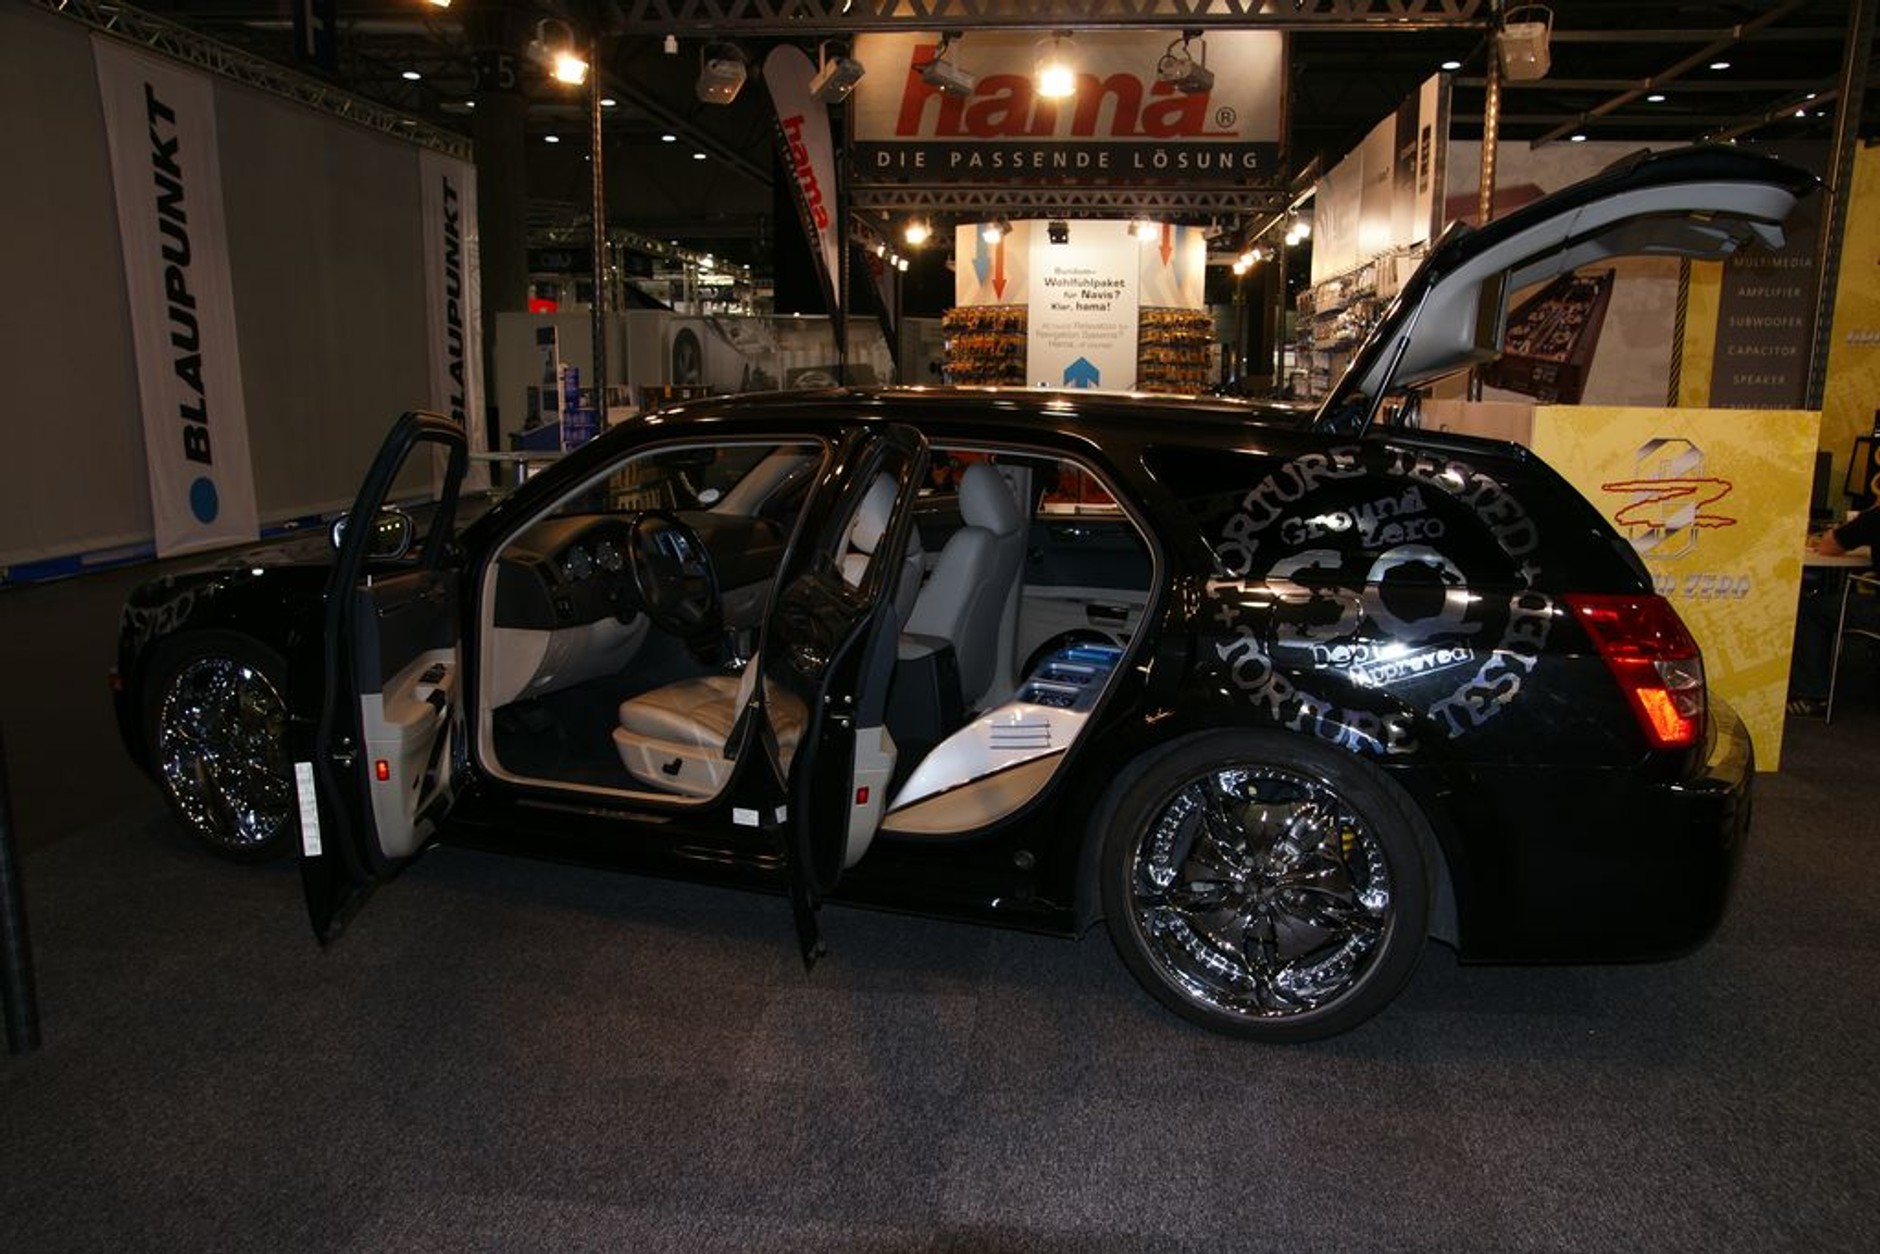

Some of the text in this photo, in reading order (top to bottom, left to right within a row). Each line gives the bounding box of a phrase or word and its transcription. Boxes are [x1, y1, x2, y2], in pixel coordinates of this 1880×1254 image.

[877, 149, 1258, 168] DIE PASSENDE LÖSUNG
[782, 115, 828, 230] hama
[144, 82, 213, 466] BLAUPUNKT
[1076, 302, 1111, 312] hama!
[1729, 316, 1802, 327] SUBWOOFER
[1728, 346, 1797, 356] CAPACITOR
[1733, 374, 1786, 384] SPEAKER
[1384, 444, 1536, 556] TESTED
[1426, 588, 1555, 738] TESTED
